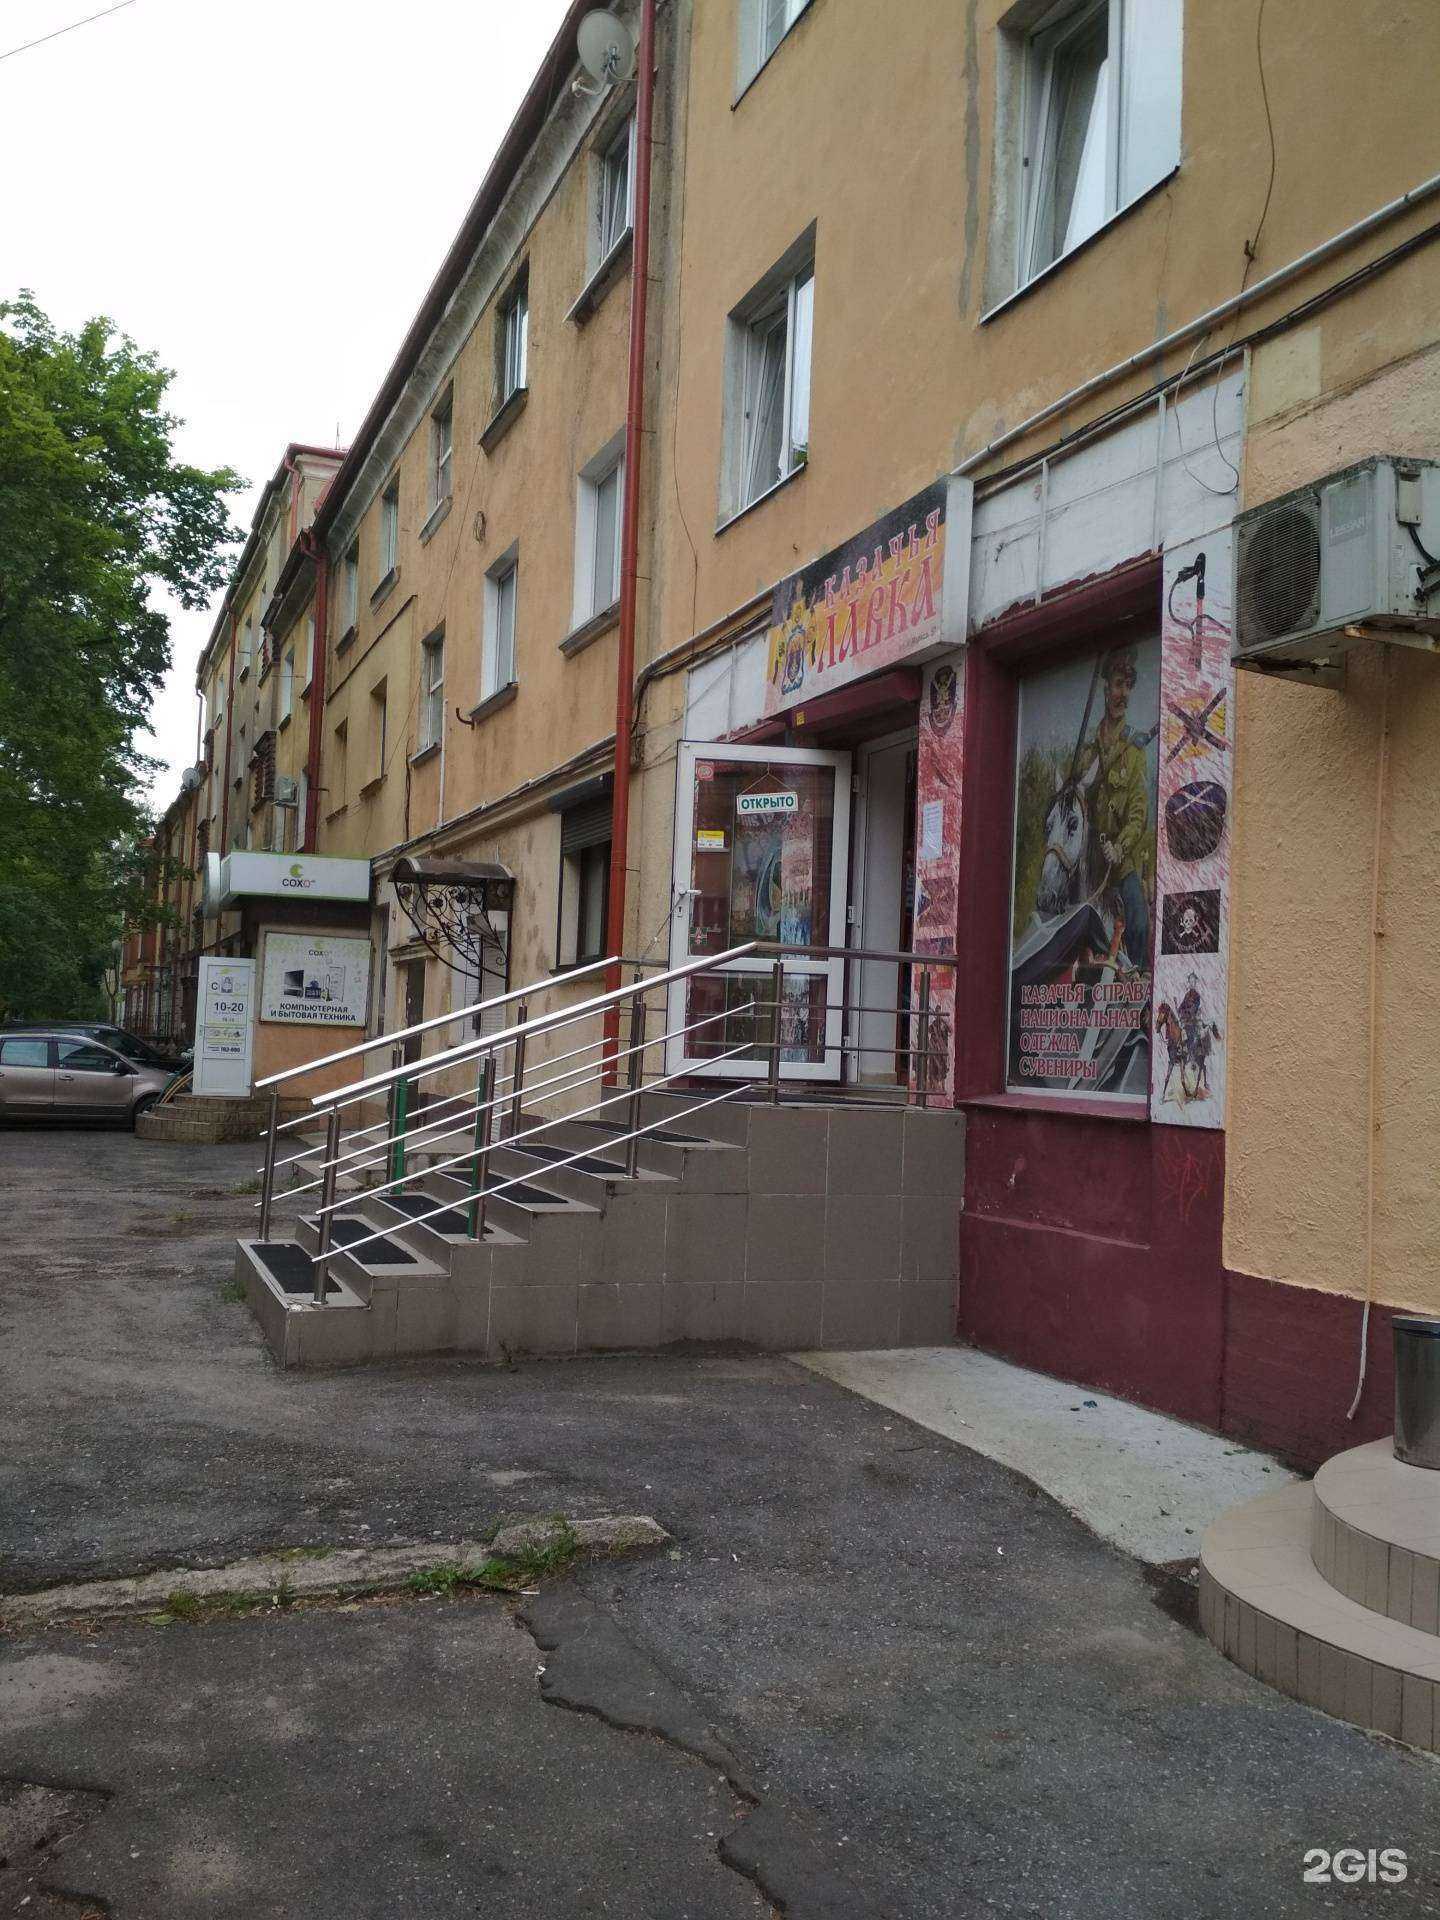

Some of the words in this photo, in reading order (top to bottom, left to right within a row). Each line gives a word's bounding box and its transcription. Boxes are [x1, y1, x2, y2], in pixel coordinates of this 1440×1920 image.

[824, 507, 941, 609] КАЗАЧЬЯ
[817, 555, 937, 674] ЛАВКА
[741, 796, 795, 809] ОТКРЫТО
[1021, 983, 1085, 1005] КАЗАЧЬЯ
[1092, 981, 1153, 1003] СПРАВА
[214, 1002, 244, 1013] 10-20
[278, 1011, 318, 1020] БЫТОВАЯ
[319, 1013, 356, 1022] ТЕХНИКА
[279, 1002, 348, 1013] КОМПЬЮТЕРНАЯ
[1020, 1008, 1141, 1029] НАЦИОНАЛЬНАЯ
[1020, 1032, 1080, 1053] ОДЕЖДА
[1020, 1056, 1097, 1080] СУВЕНИРЫ
